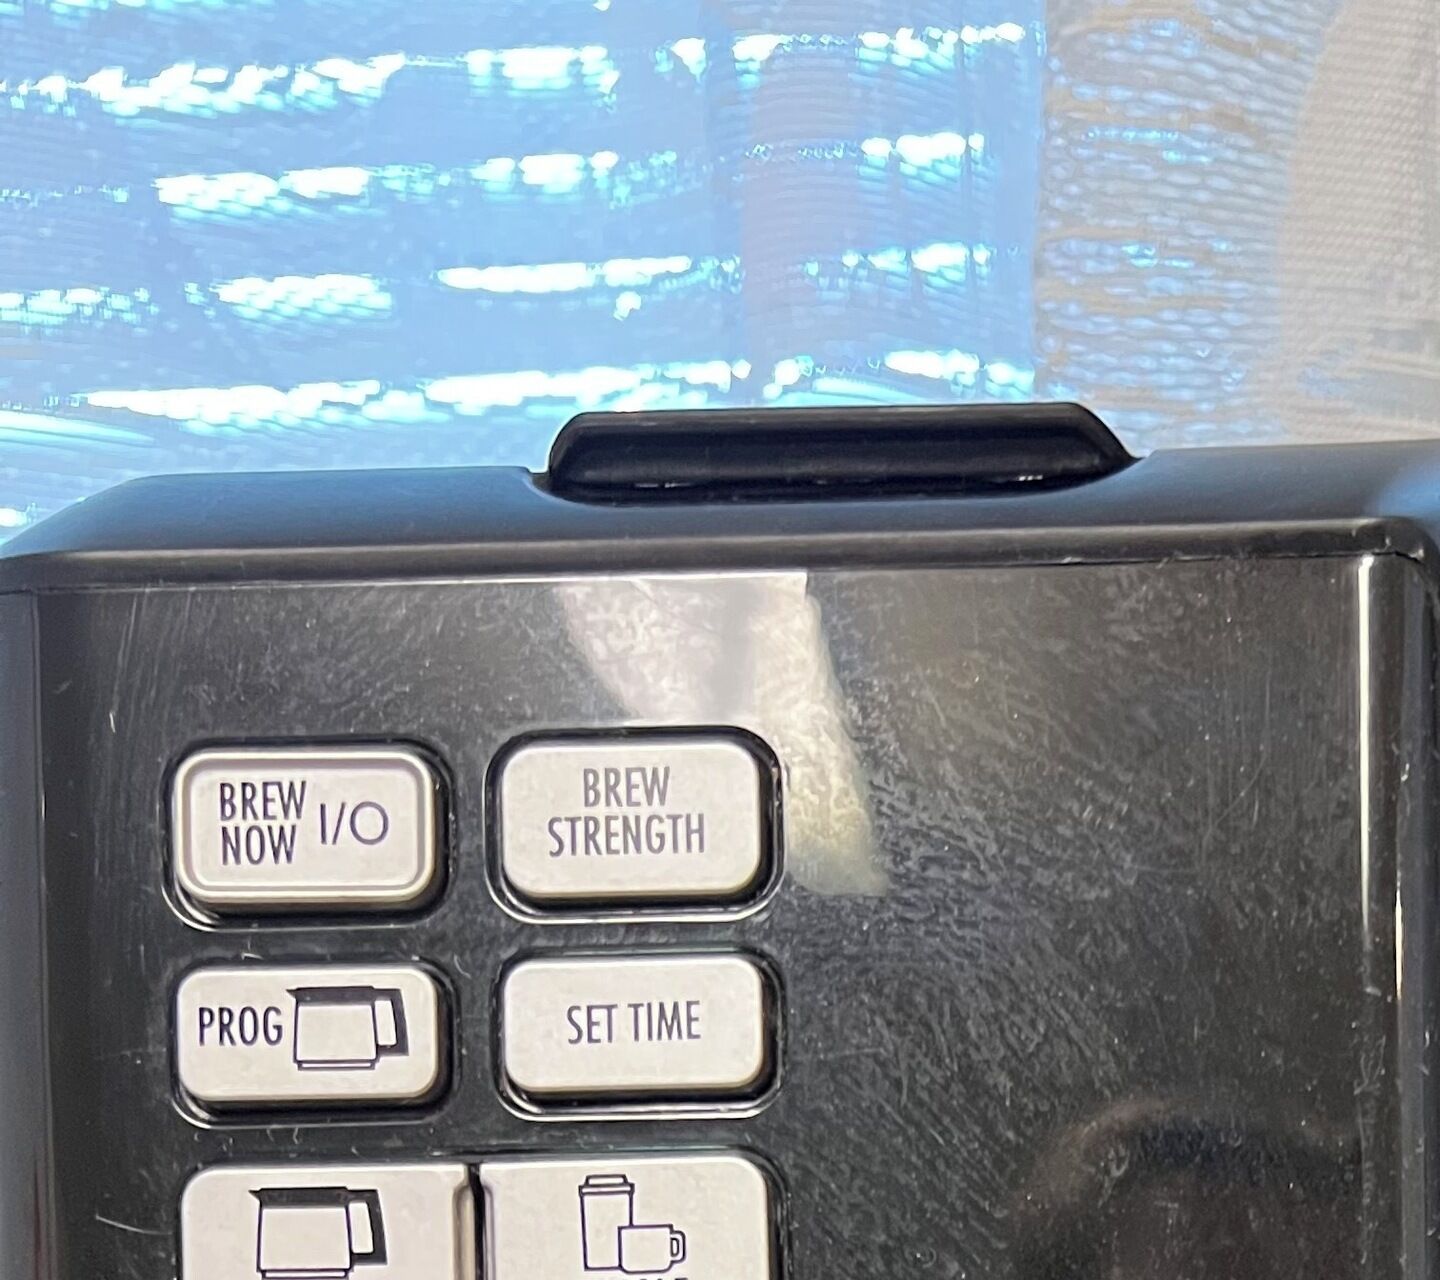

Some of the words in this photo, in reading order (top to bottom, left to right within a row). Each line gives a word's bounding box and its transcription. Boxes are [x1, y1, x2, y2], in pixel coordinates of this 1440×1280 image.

[218, 780, 307, 822] BREW
[582, 766, 671, 808] BREW
[221, 825, 298, 866] NOW
[547, 813, 706, 858] STRENGTH
[198, 1005, 284, 1047] PROG
[566, 1004, 619, 1044] SET
[627, 1000, 702, 1042] TIME
